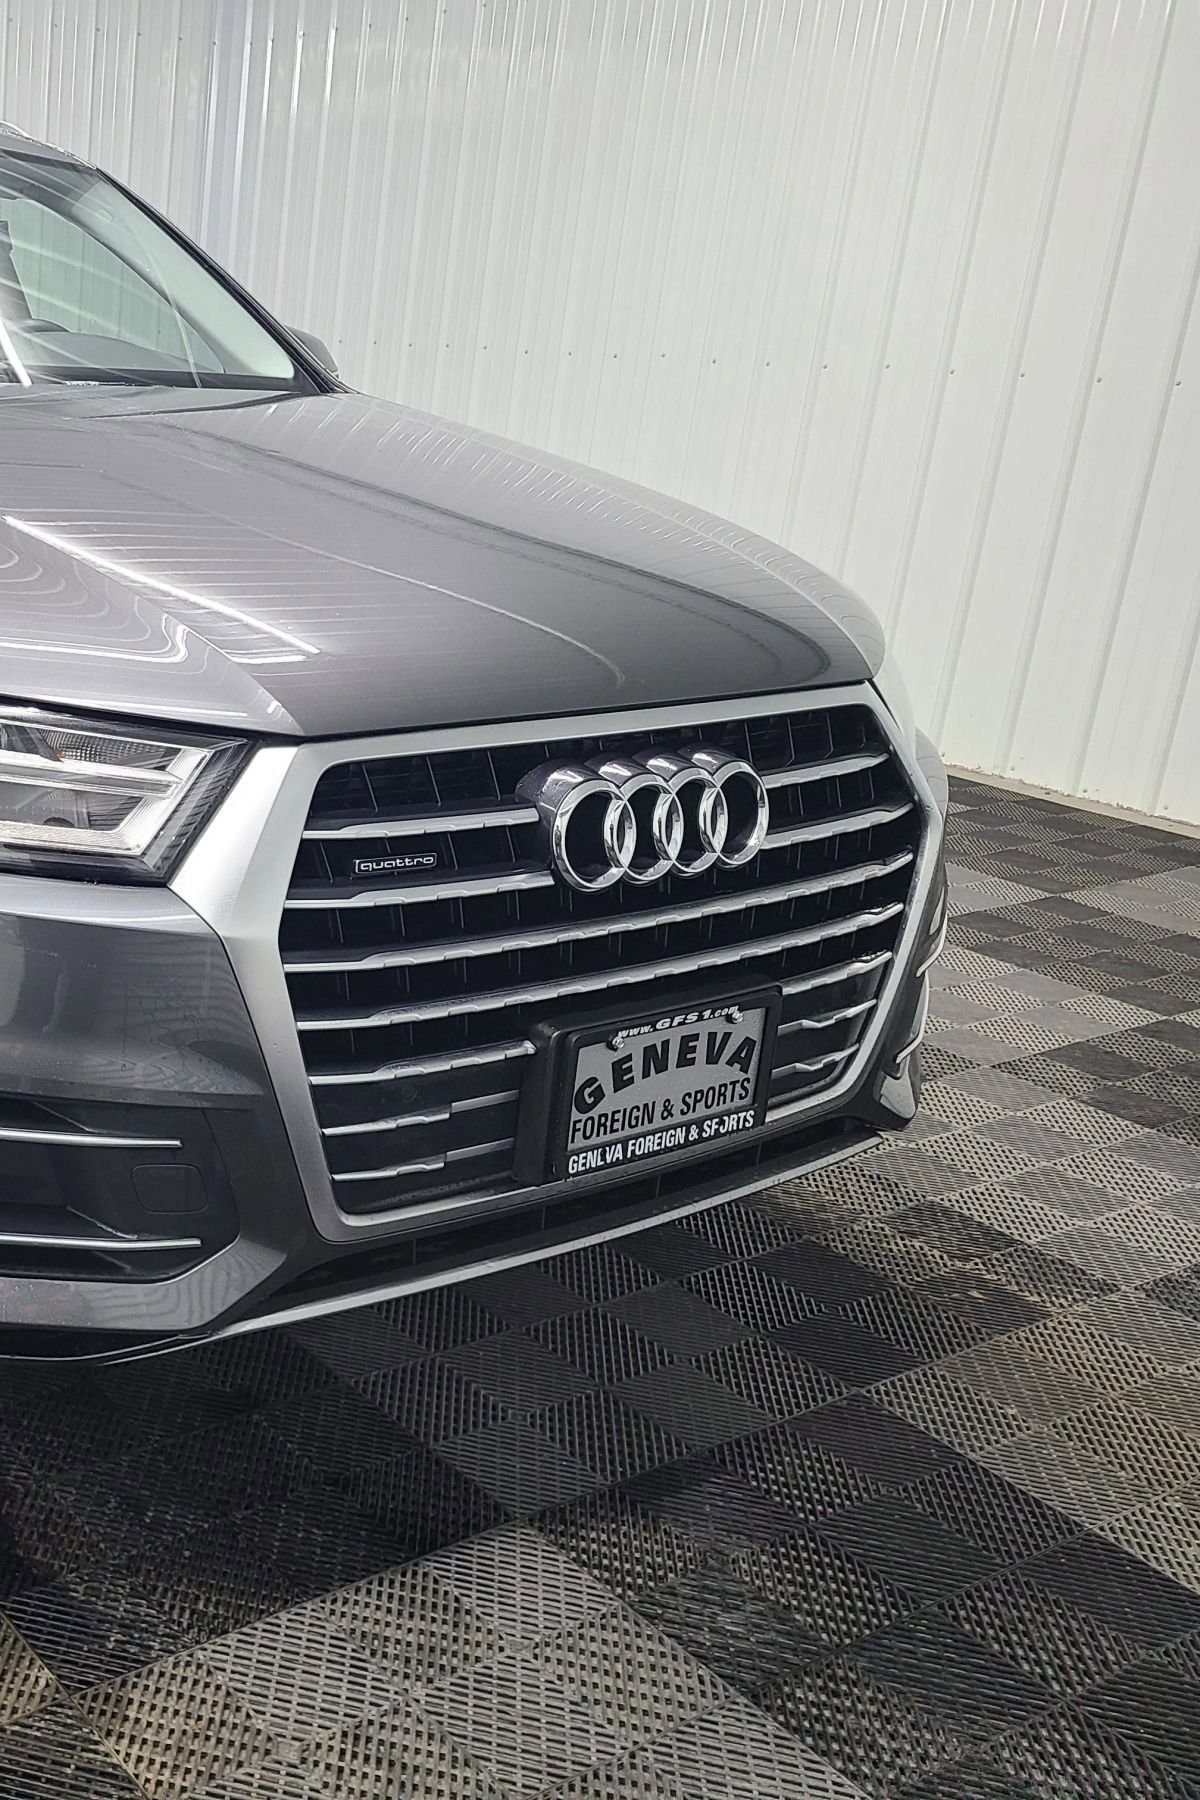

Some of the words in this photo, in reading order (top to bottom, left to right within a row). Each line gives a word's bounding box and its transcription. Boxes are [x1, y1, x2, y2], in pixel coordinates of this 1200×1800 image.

[360, 856, 434, 872] quattro
[573, 1031, 757, 1115] GENEVA
[570, 1100, 657, 1144] FOREIGN
[660, 1098, 674, 1121] &
[679, 1077, 751, 1116] SPORTS
[626, 1129, 686, 1158] FOREIGN
[688, 1124, 699, 1141] &
